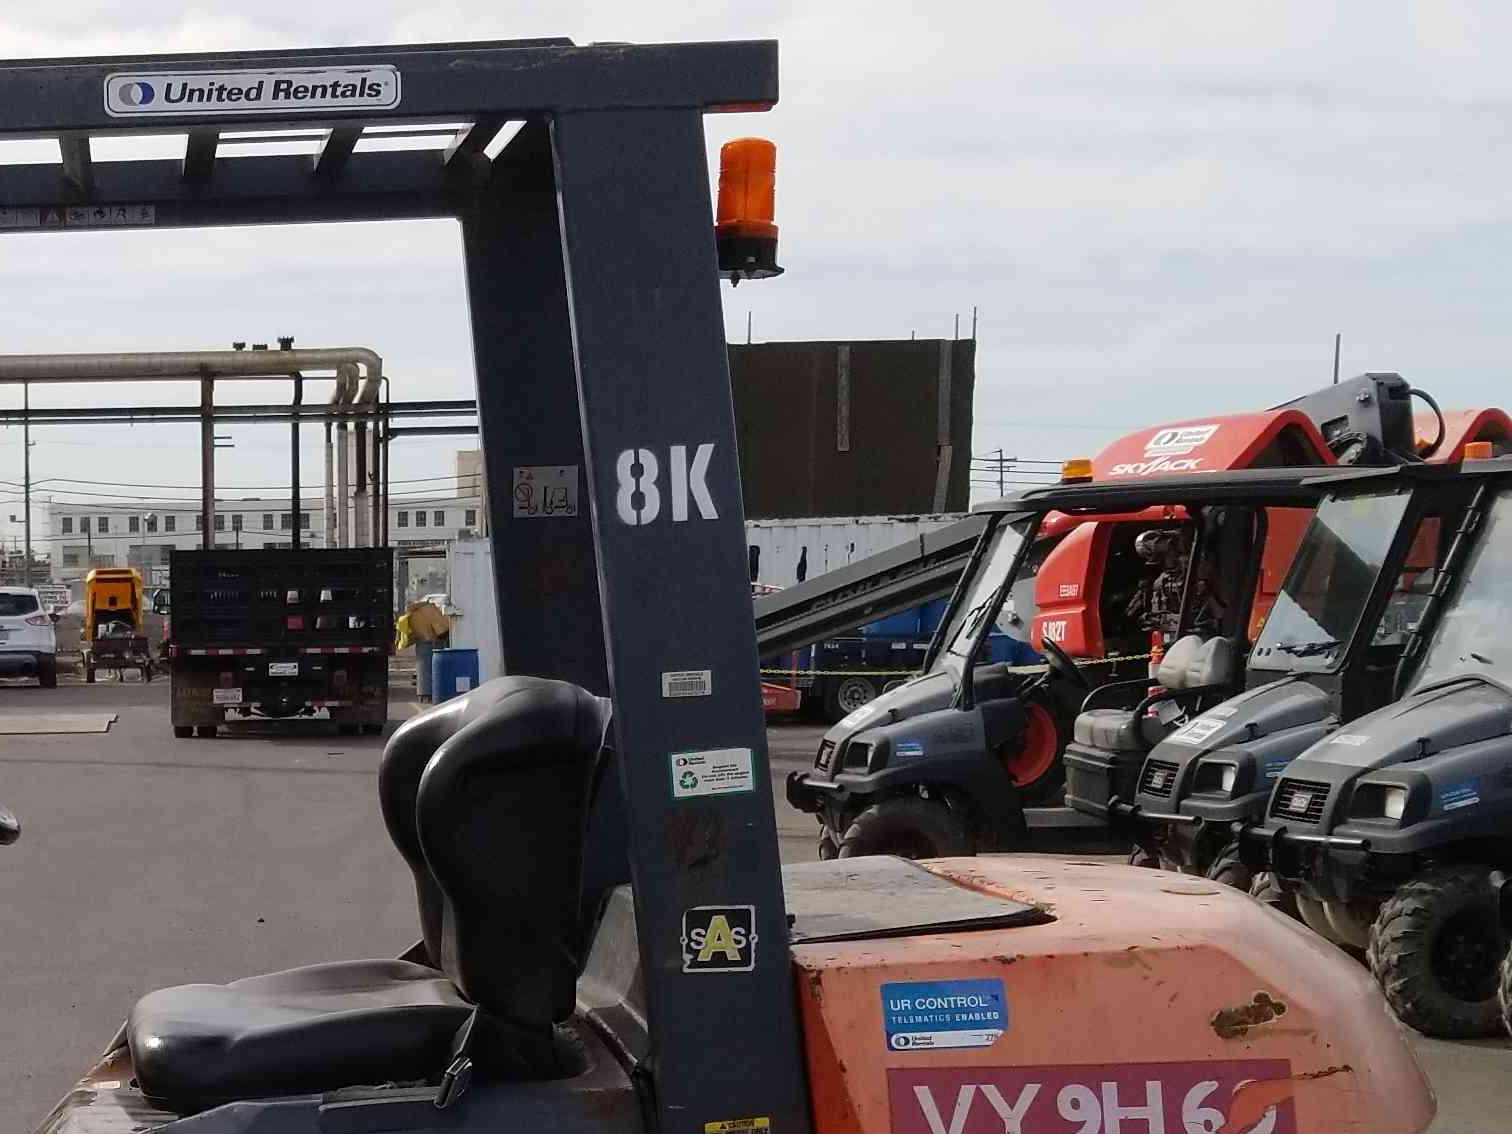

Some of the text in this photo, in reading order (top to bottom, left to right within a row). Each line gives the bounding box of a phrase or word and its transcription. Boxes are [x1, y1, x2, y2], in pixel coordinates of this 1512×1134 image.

[164, 76, 382, 104] United Rentals
[1108, 456, 1204, 476] SKYJACK
[616, 443, 719, 526] 8K
[690, 915, 748, 962] SAS
[889, 995, 989, 1012] UR CONTROL
[891, 1011, 1000, 1025] TELEMATICS ENABLED
